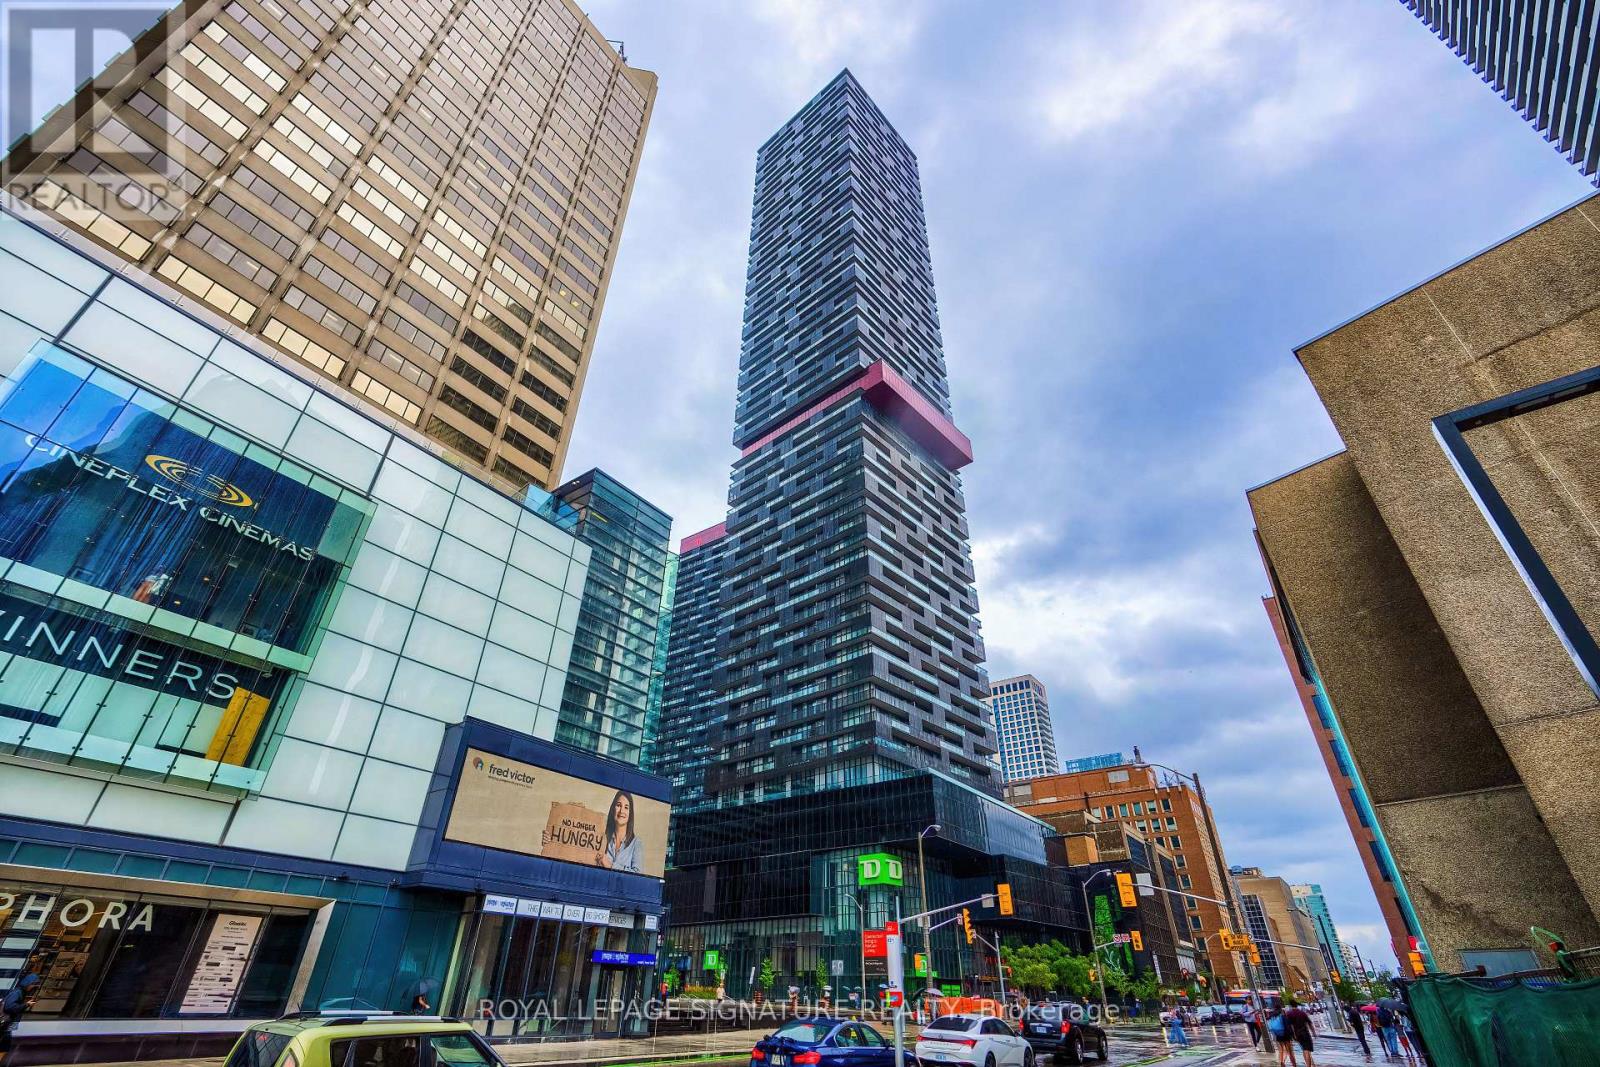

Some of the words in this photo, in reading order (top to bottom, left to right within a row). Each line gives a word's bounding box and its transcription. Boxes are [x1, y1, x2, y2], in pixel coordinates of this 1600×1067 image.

[25, 434, 192, 512] CINEPLEX
[200, 506, 316, 561] CINEMAS
[0, 610, 239, 699] INNERS
[489, 764, 509, 778] fred
[510, 770, 535, 785] victor
[551, 825, 603, 851] HUNGRY
[562, 819, 571, 827] NO
[573, 821, 596, 832] LONGER
